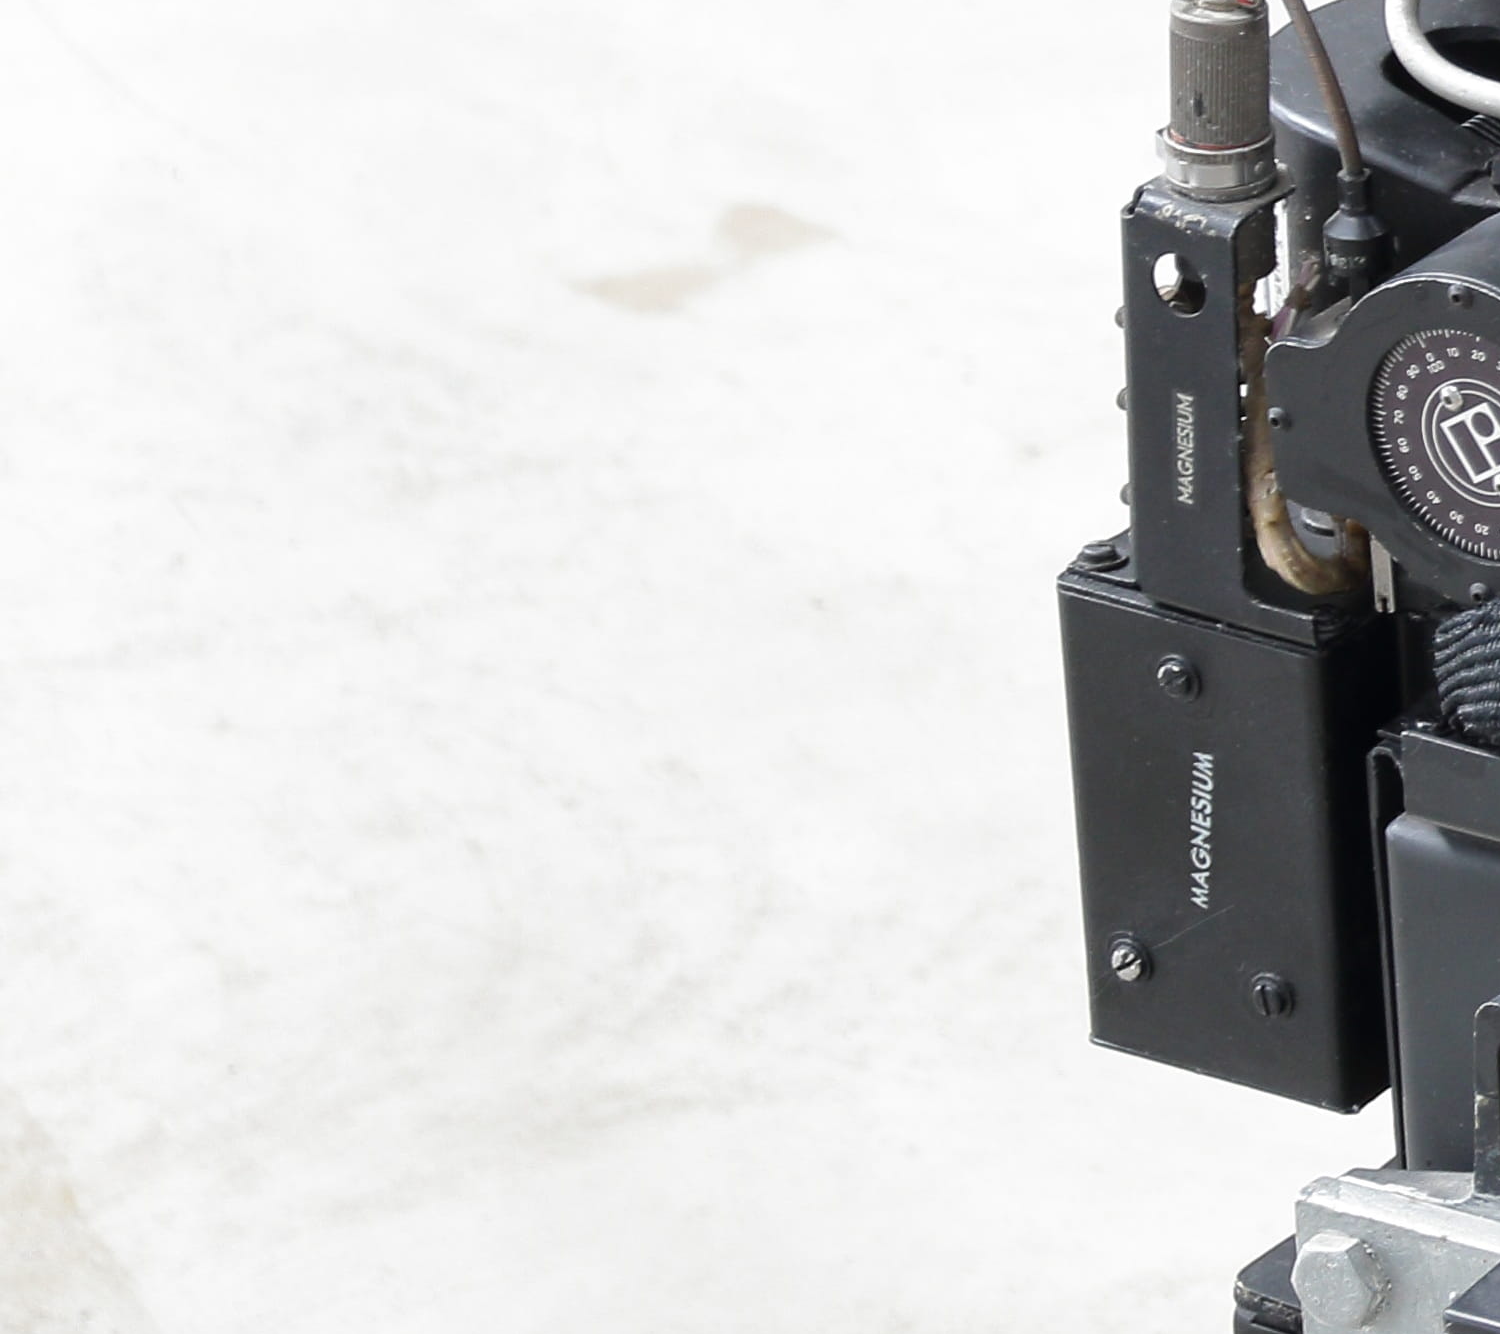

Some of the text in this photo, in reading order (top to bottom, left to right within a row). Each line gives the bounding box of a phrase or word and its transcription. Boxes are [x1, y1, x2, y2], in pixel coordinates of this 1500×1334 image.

[1472, 350, 1485, 361] 20
[1177, 394, 1193, 503] MAGNESIUM
[1191, 754, 1212, 906] MAGNESIUM
